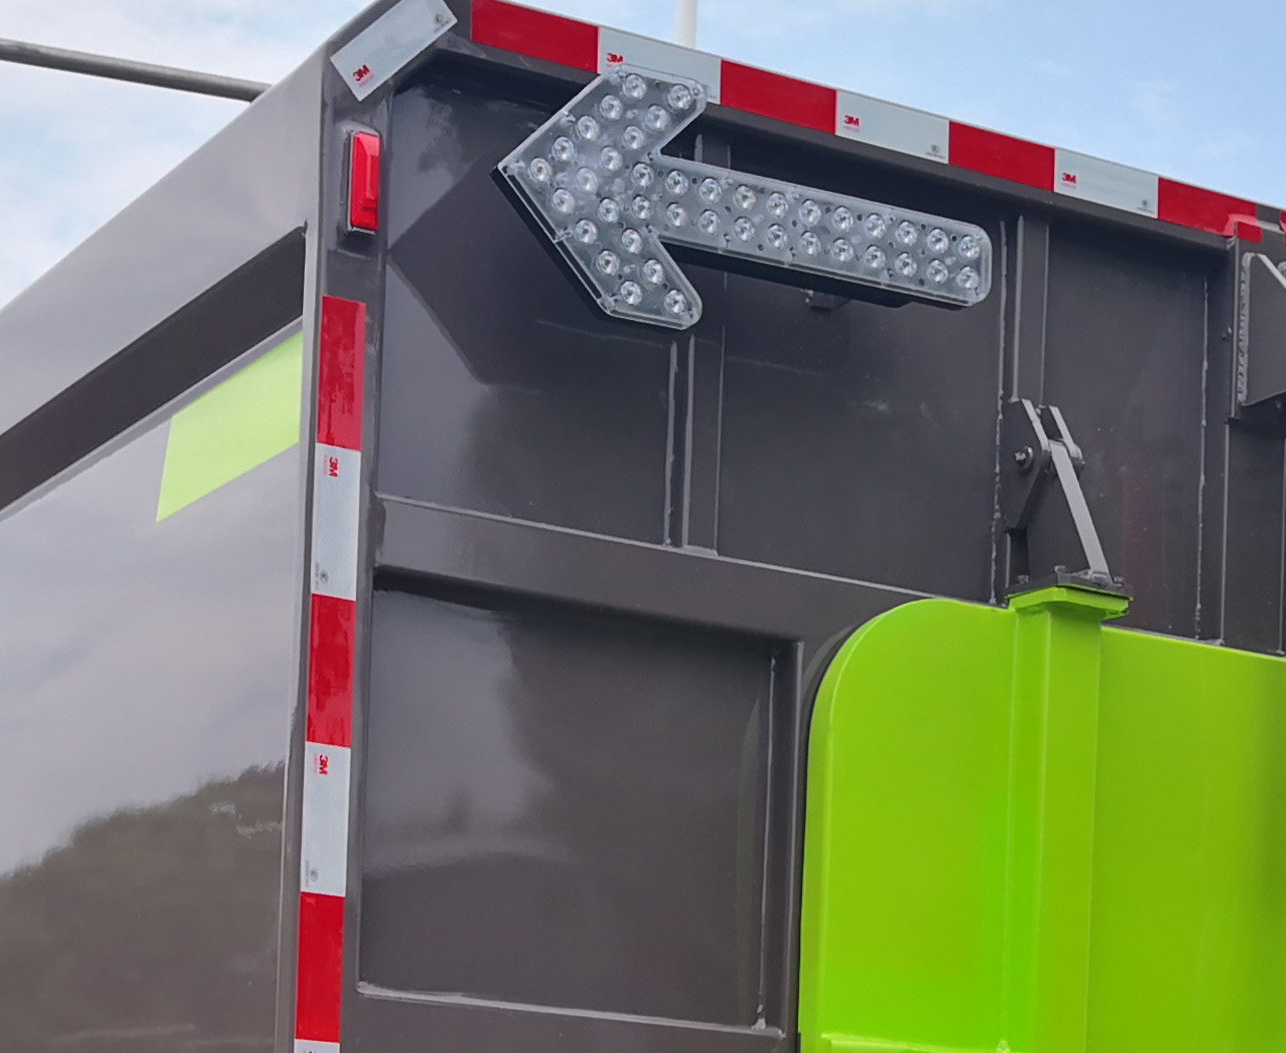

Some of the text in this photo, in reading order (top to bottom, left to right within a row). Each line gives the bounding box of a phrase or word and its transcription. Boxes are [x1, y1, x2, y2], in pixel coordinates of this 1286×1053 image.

[607, 53, 623, 64] 3M
[353, 64, 370, 81] 3M
[844, 115, 859, 126] 3M
[1062, 172, 1076, 183] 3M
[329, 457, 339, 477] 3M
[318, 755, 329, 775] 3M
